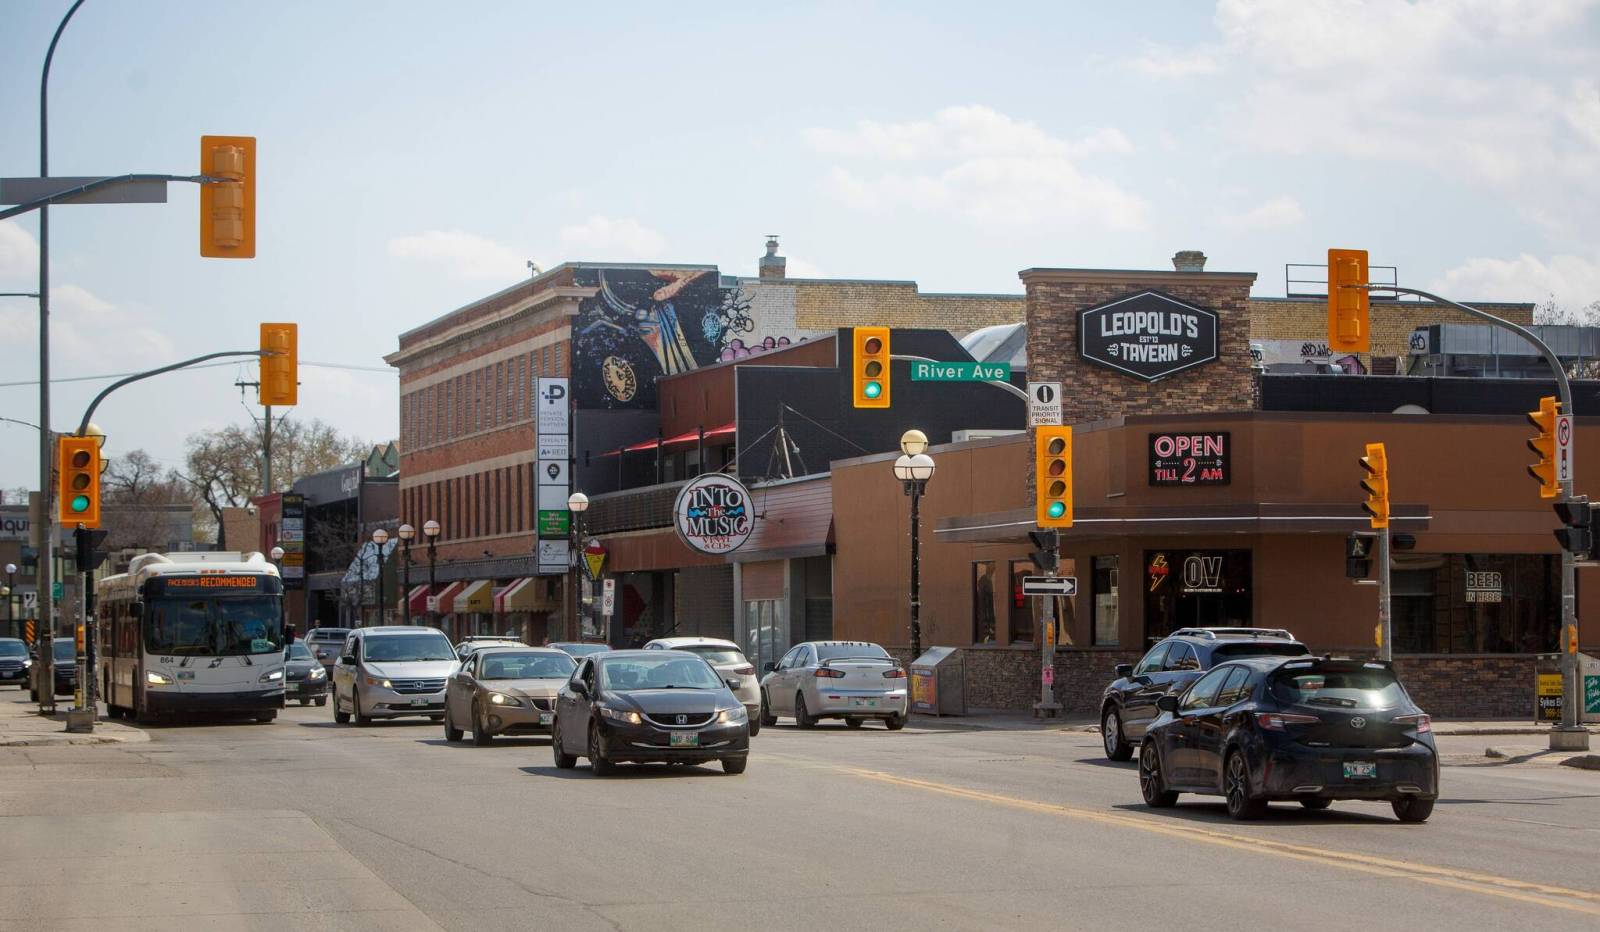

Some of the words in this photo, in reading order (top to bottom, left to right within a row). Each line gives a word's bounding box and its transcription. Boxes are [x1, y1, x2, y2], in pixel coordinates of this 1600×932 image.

[1101, 311, 1198, 338] LEOPOLD'S
[1120, 343, 1179, 362] TAVERN
[918, 364, 964, 378] River
[972, 364, 1004, 378] Ave
[1154, 435, 1223, 458] OPEN
[1154, 469, 1178, 481] TILL
[1181, 457, 1196, 482] 2
[1200, 468, 1223, 480] AM
[690, 486, 743, 508] INTO
[686, 515, 749, 537] MUSIC
[200, 577, 257, 588] RECOMMENDED
[1184, 556, 1223, 588] OV
[1466, 571, 1502, 587] BEER
[160, 656, 174, 664] 864
